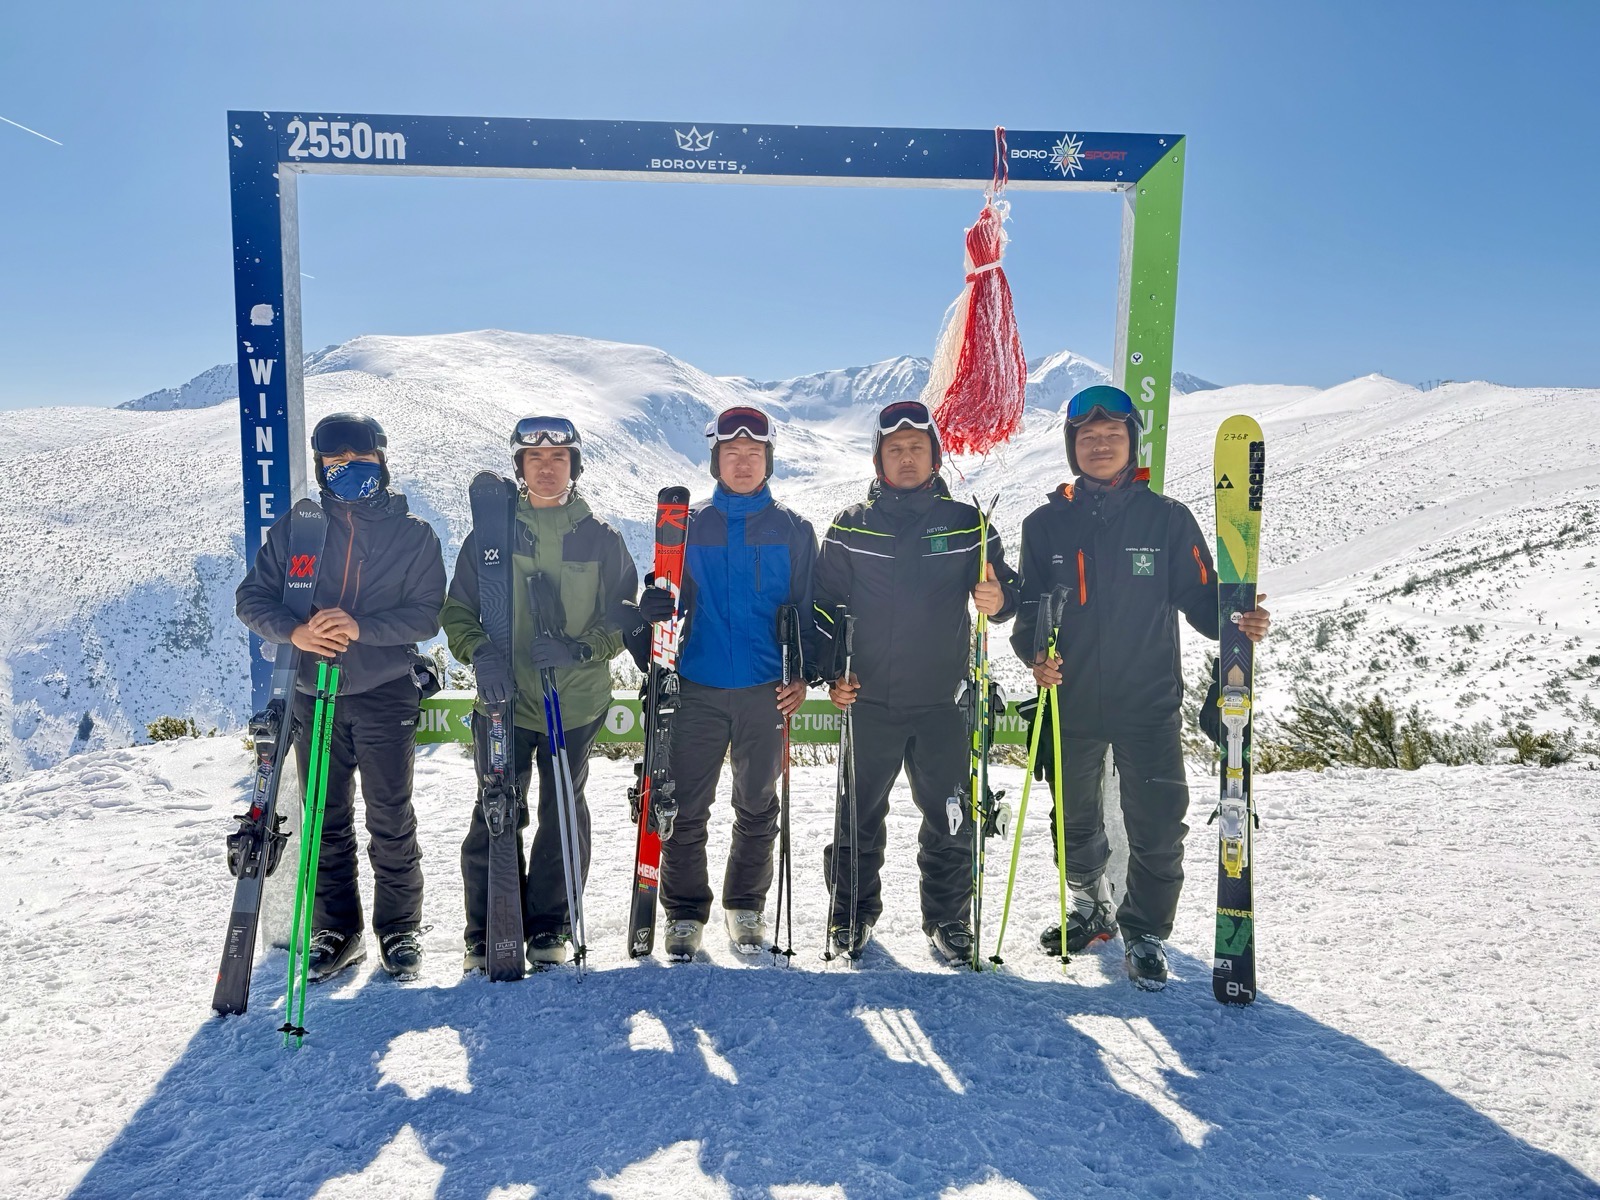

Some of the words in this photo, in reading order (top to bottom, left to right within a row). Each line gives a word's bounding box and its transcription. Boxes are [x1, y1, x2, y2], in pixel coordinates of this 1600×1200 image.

[287, 120, 406, 160] 2550m
[1010, 149, 1048, 160] BORO
[1085, 150, 1128, 161] SPORT
[651, 158, 738, 171] BOROVETS
[1223, 432, 1249, 442] 2768
[1248, 440, 1266, 512] FISCHER
[1217, 907, 1254, 919] RANGER
[1225, 981, 1253, 1000] 84
